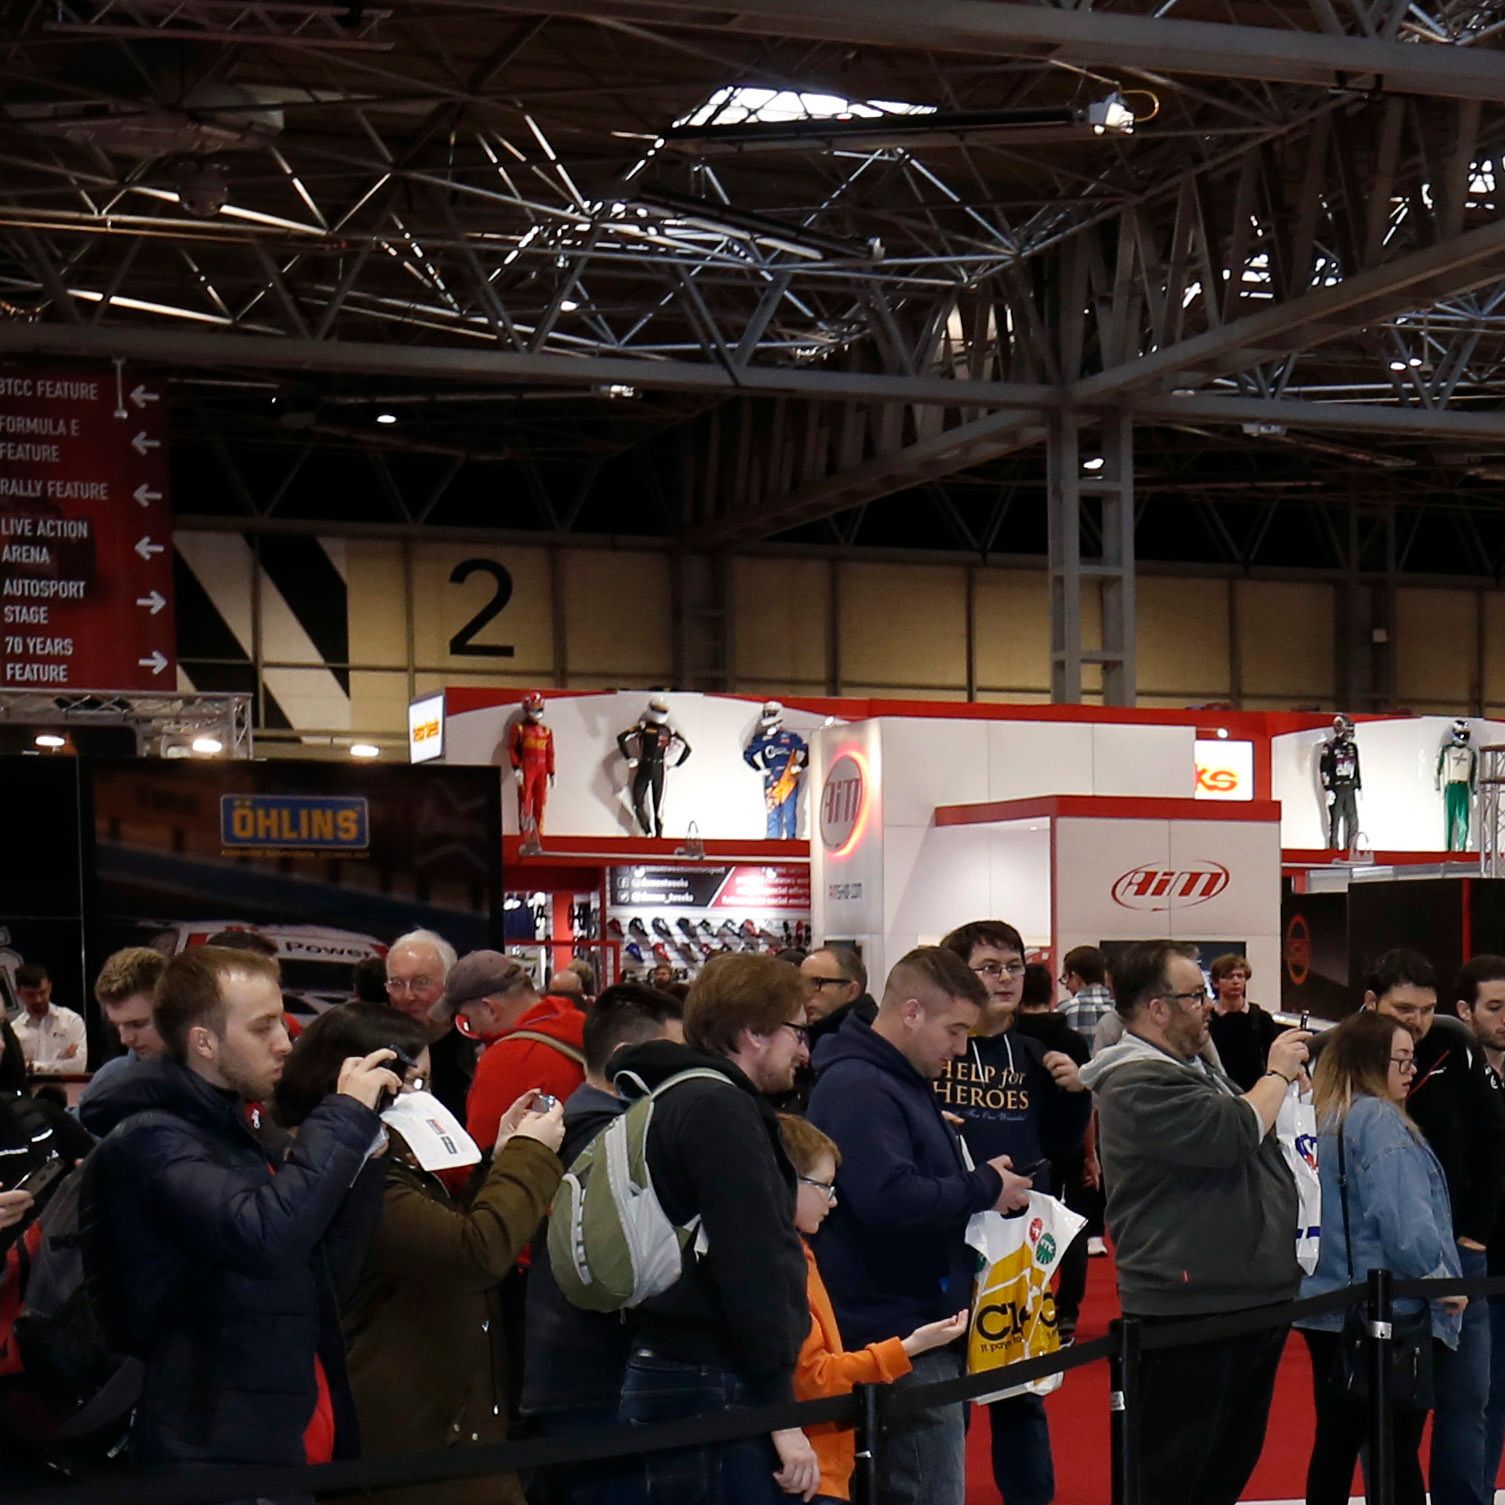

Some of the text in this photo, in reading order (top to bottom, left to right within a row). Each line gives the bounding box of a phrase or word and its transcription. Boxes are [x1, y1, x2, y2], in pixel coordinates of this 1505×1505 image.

[37, 380, 98, 400] FEATURE
[0, 416, 80, 436] FORMULA E
[0, 443, 60, 463] FEATURE
[1, 480, 109, 500] RALLY FEATURE
[1, 519, 88, 538] LIVE ACTION
[2, 545, 50, 564] ARENA
[3, 579, 86, 599] AUTOSPORT
[4, 606, 48, 625] STAGE
[448, 558, 515, 657] 2
[5, 636, 73, 656] 70 YEARS
[6, 662, 68, 682] FEATURE
[231, 799, 359, 841] ÖHLINS
[285, 940, 372, 959] Power
[1001, 1064, 1026, 1088] for
[932, 1081, 1030, 1111] HEROES
